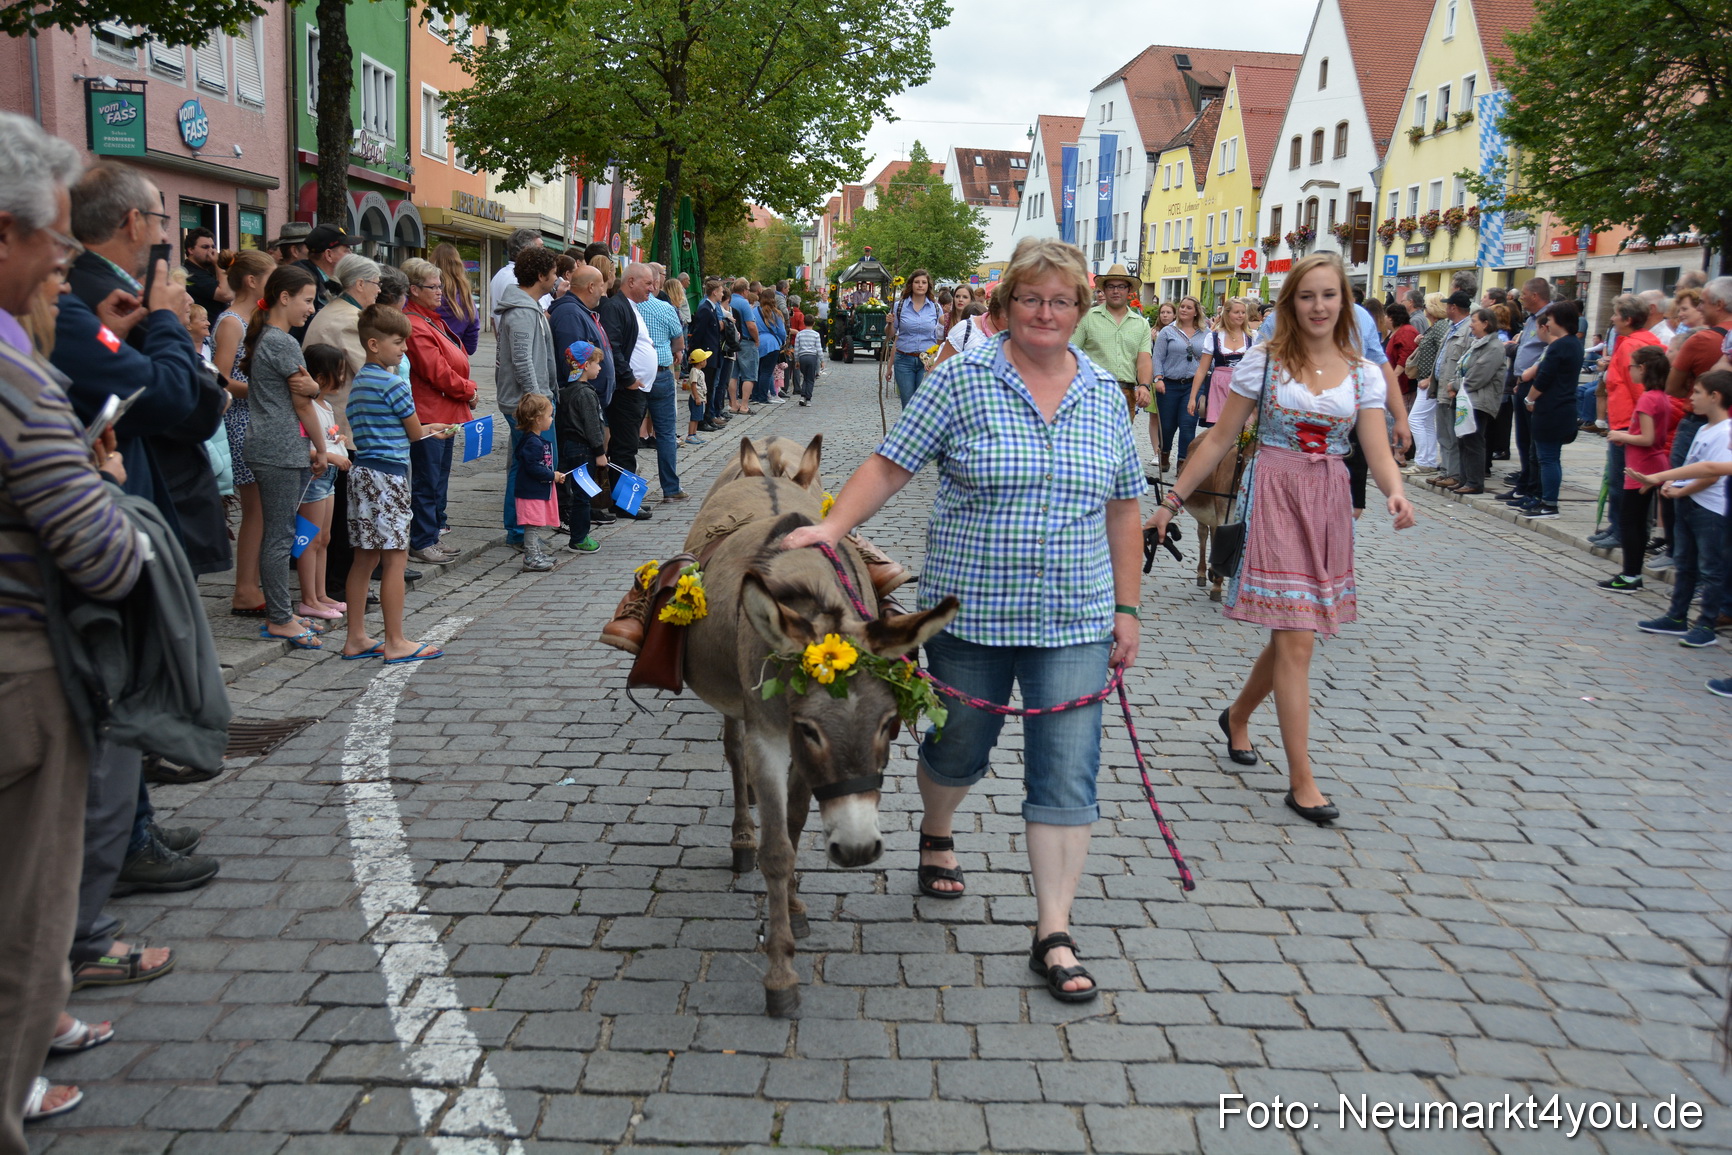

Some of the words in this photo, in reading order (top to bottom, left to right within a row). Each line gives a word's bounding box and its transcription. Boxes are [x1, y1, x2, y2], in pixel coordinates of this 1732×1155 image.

[99, 103, 119, 114] vom
[106, 107, 137, 124] FASS
[179, 105, 194, 122] vom
[185, 117, 208, 142] FASS
[1099, 175, 1108, 201] K&L
[1167, 203, 1182, 216] HOTEL
[1385, 257, 1395, 273] P
